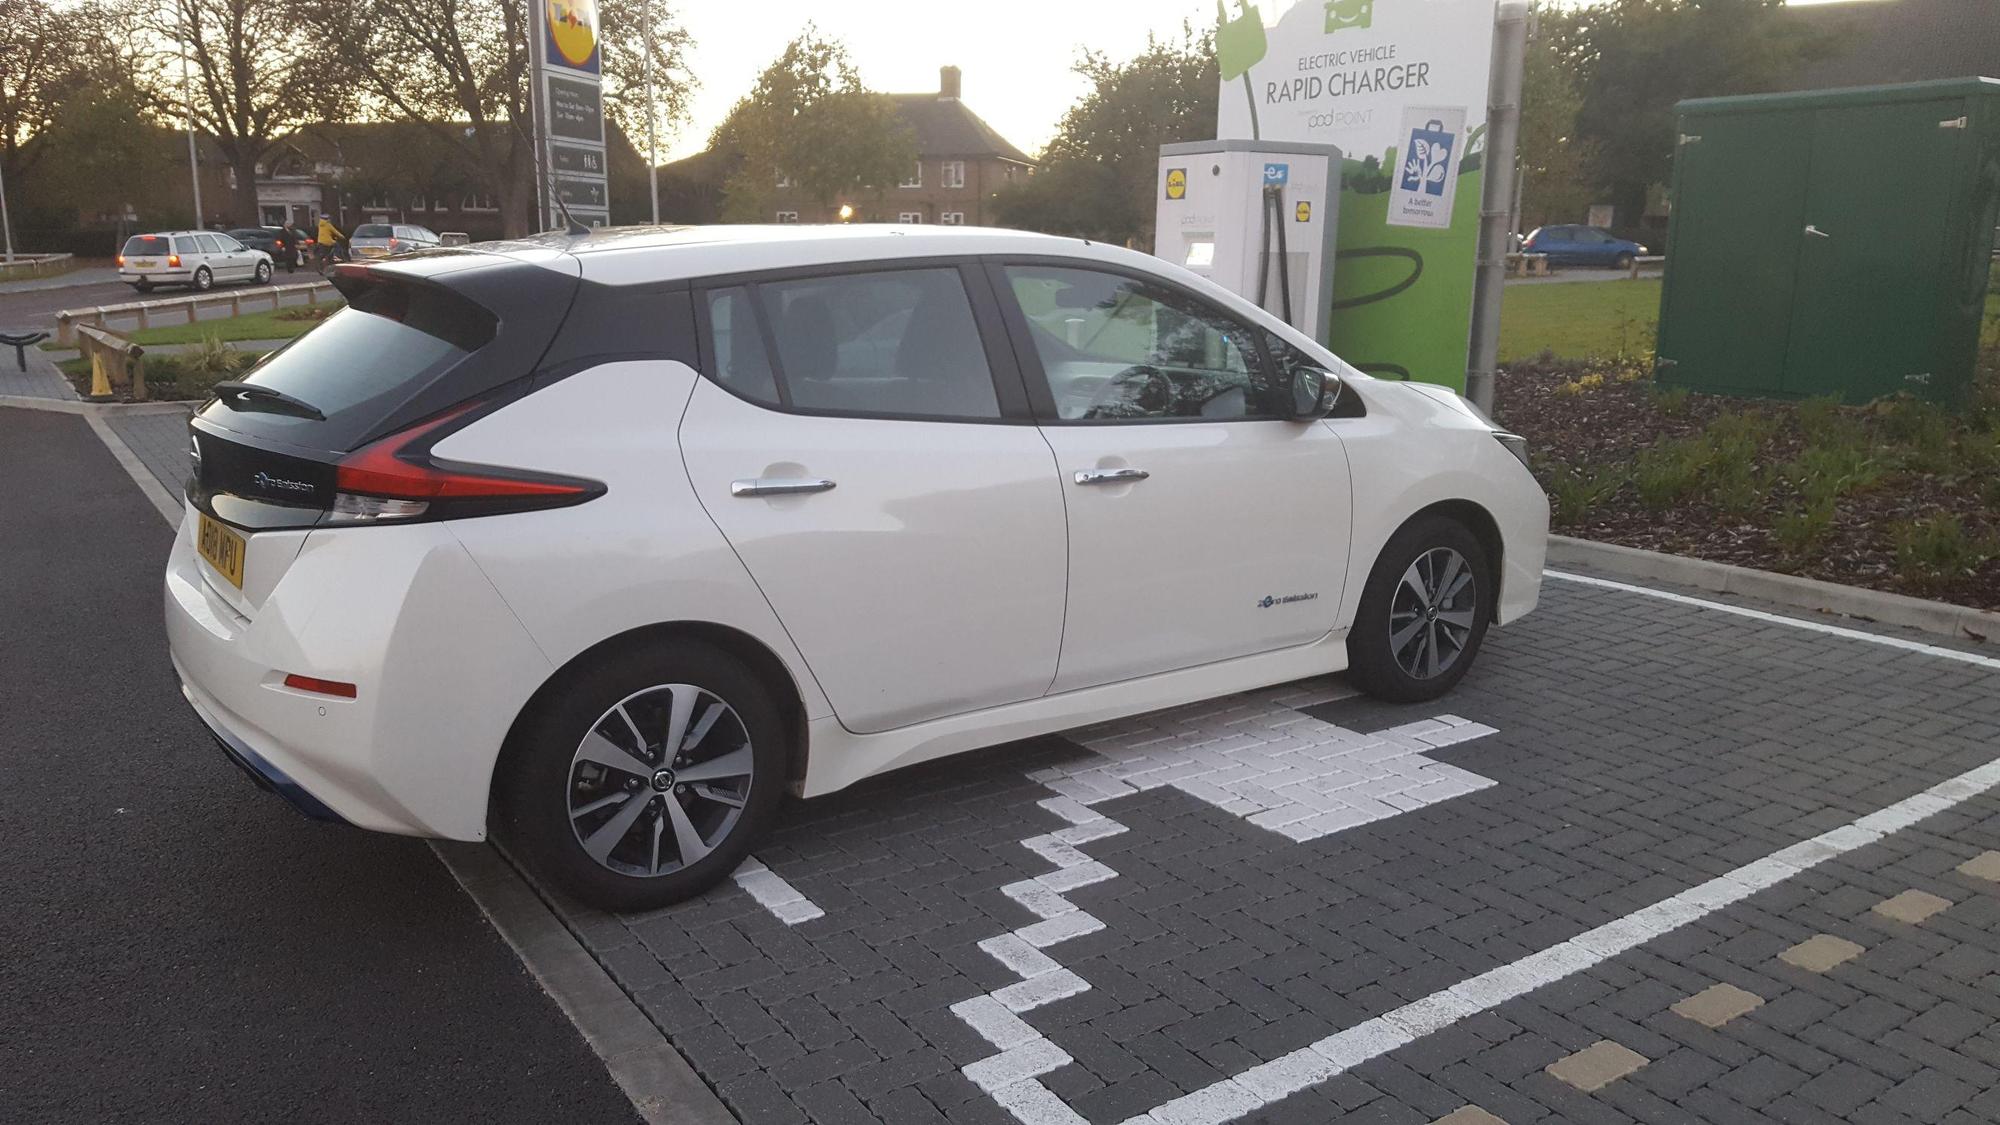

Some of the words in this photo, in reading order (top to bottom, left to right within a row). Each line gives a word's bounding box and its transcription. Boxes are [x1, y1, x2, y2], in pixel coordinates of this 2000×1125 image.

[1298, 51, 1347, 71] ELECTRIC
[1350, 44, 1396, 63] VEHICLE
[1266, 76, 1323, 104] RAPID
[1328, 62, 1430, 97] CHARGER
